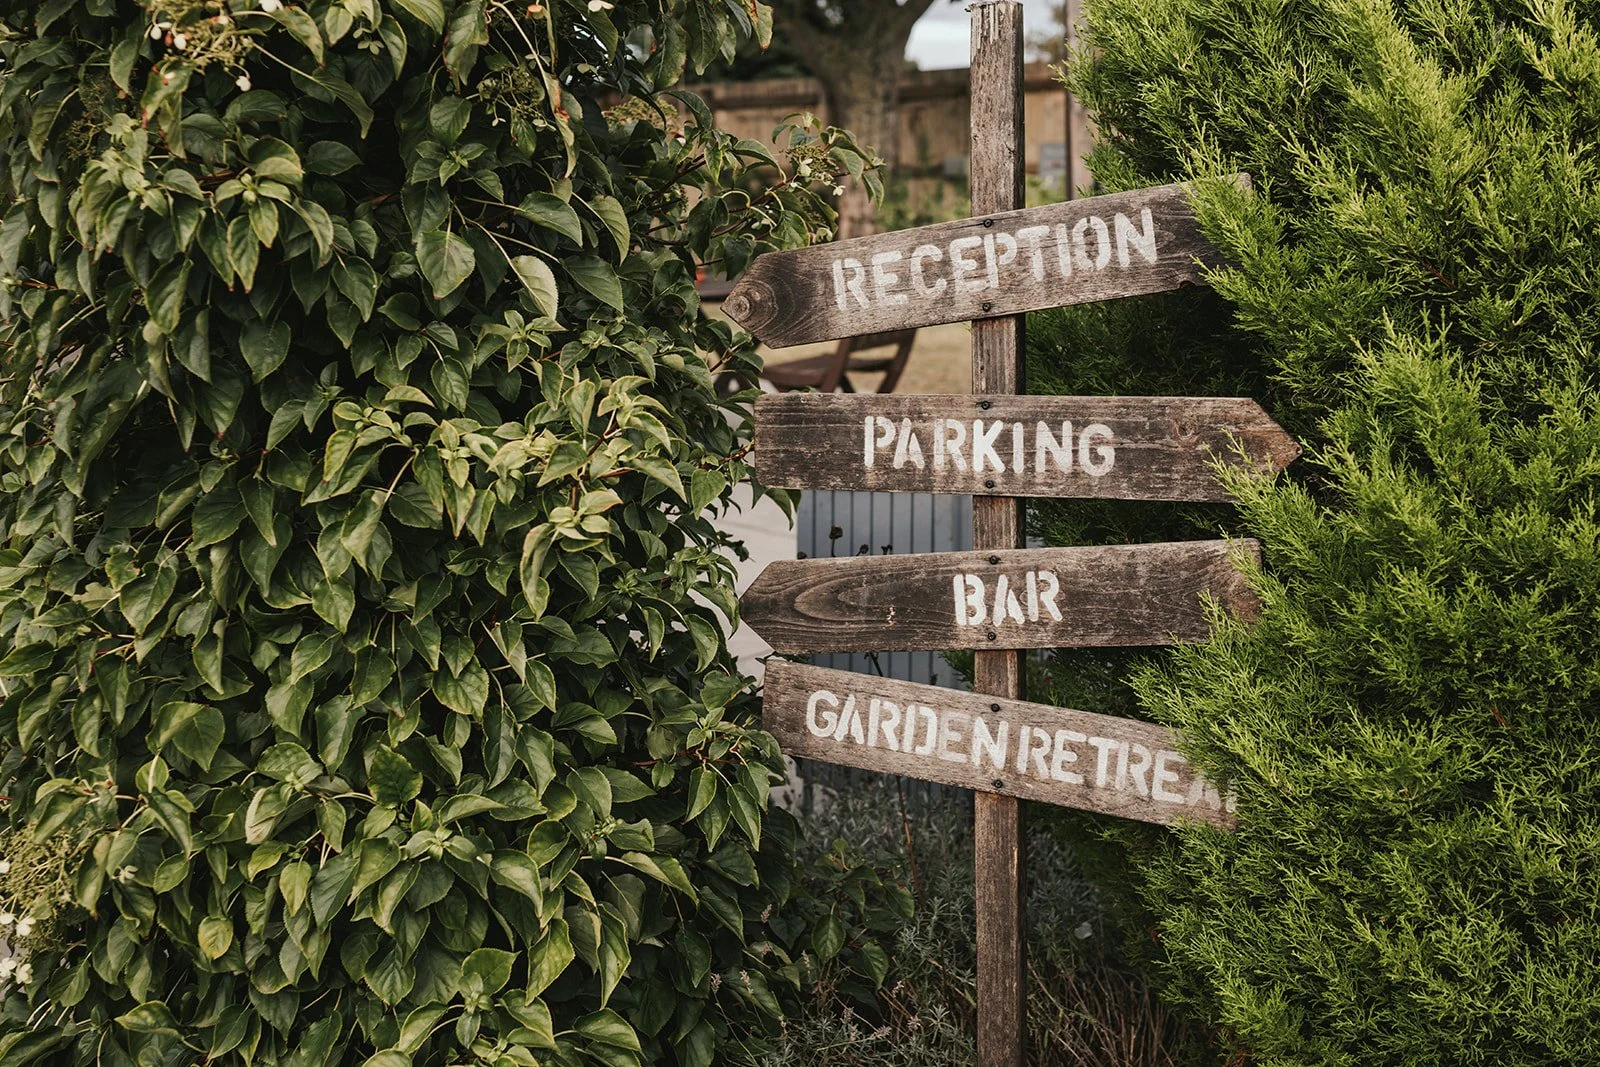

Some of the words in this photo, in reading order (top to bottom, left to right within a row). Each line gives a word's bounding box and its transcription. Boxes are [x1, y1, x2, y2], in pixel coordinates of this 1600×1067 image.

[832, 208, 1158, 311] RECEPTION
[864, 416, 1116, 477] PARKING
[953, 569, 1063, 628] BAR
[805, 689, 1009, 771] GARDEN
